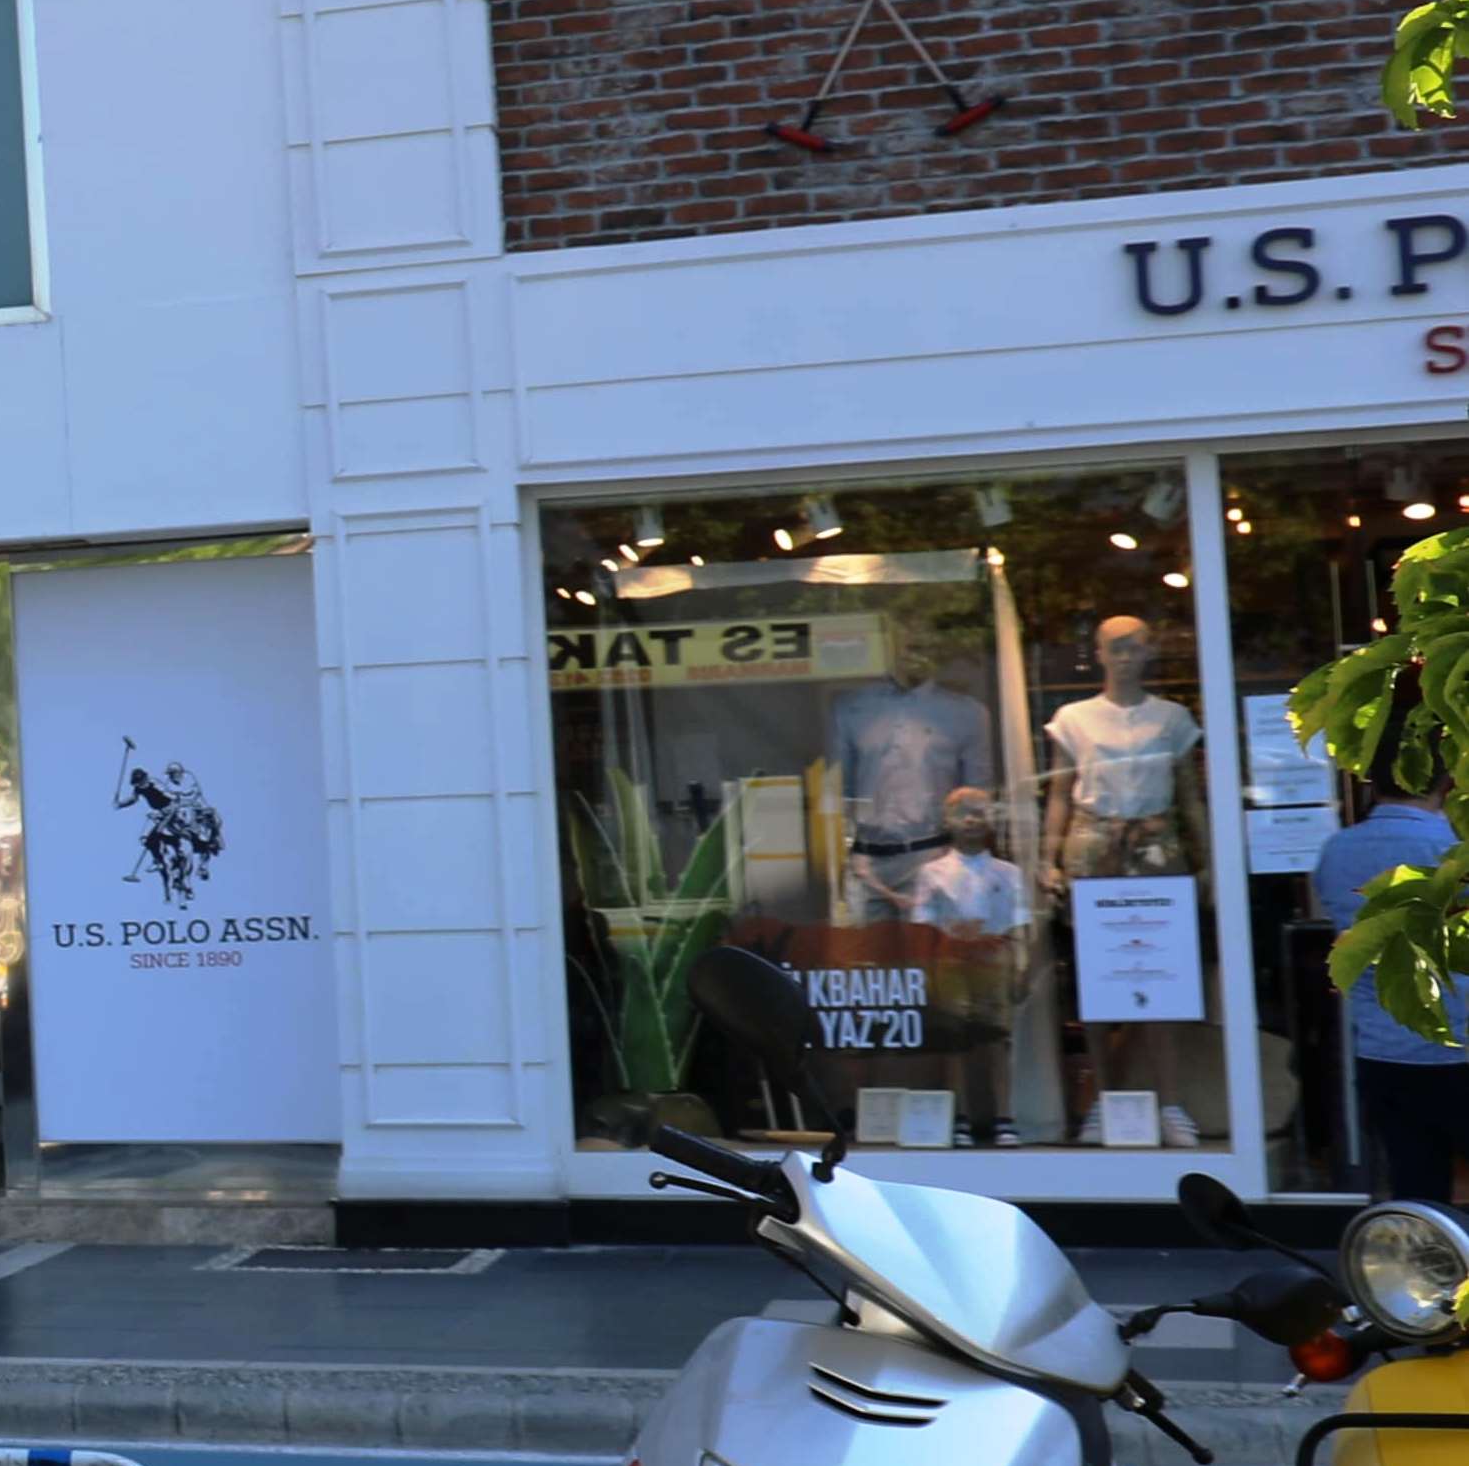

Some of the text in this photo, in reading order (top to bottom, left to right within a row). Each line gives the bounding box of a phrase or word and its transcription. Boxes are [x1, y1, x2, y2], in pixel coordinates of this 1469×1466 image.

[1124, 226, 1353, 316] U.S.
[52, 915, 320, 948] U.S. POLO ASSN.
[130, 950, 243, 970] SINCE 1890
[793, 966, 928, 1008] KBAHAR
